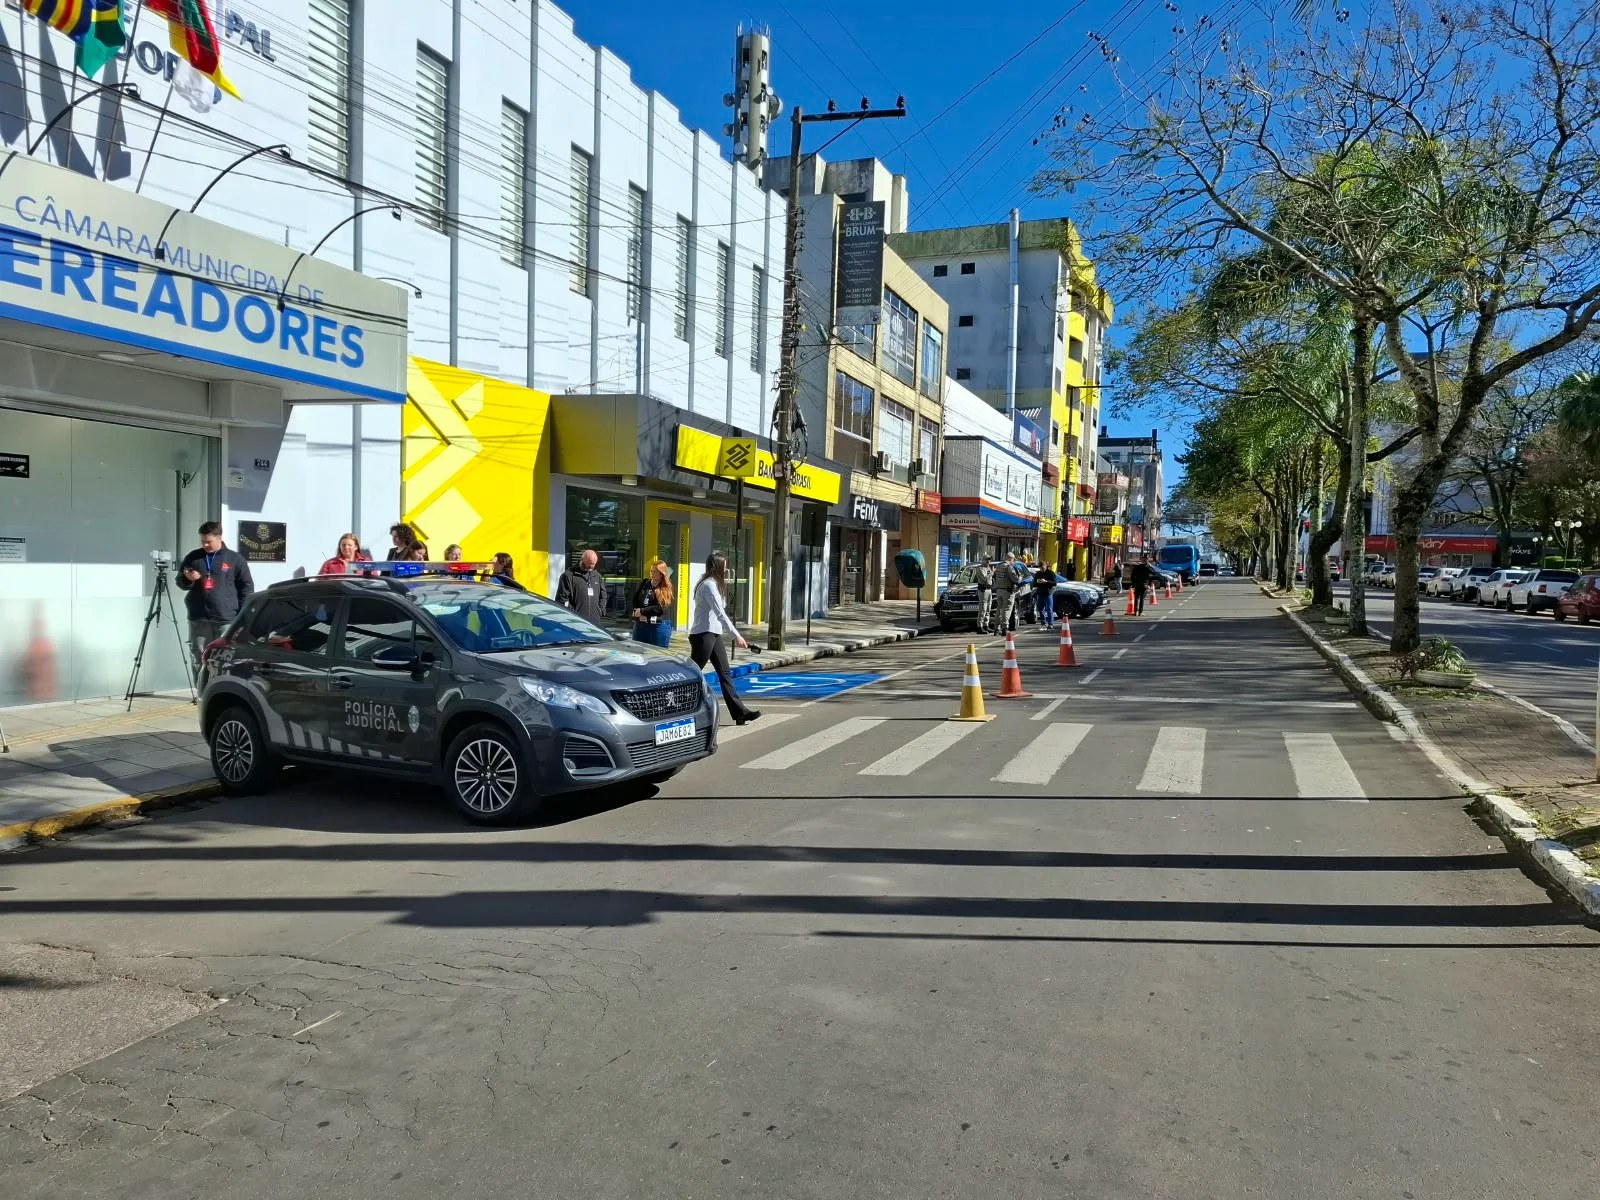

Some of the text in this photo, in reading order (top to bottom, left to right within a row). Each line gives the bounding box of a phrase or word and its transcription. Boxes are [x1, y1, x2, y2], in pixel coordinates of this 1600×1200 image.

[845, 225, 876, 237] BRUM
[15, 195, 325, 304] CÂMARA MUNICIPAL DE
[0, 224, 365, 369] EREADORES
[853, 495, 879, 523] Fênix
[1416, 537, 1447, 550] ndry
[344, 700, 396, 719] POLÍCIA
[345, 714, 405, 733] JUDICIAL
[659, 724, 692, 742] JAM6E82
